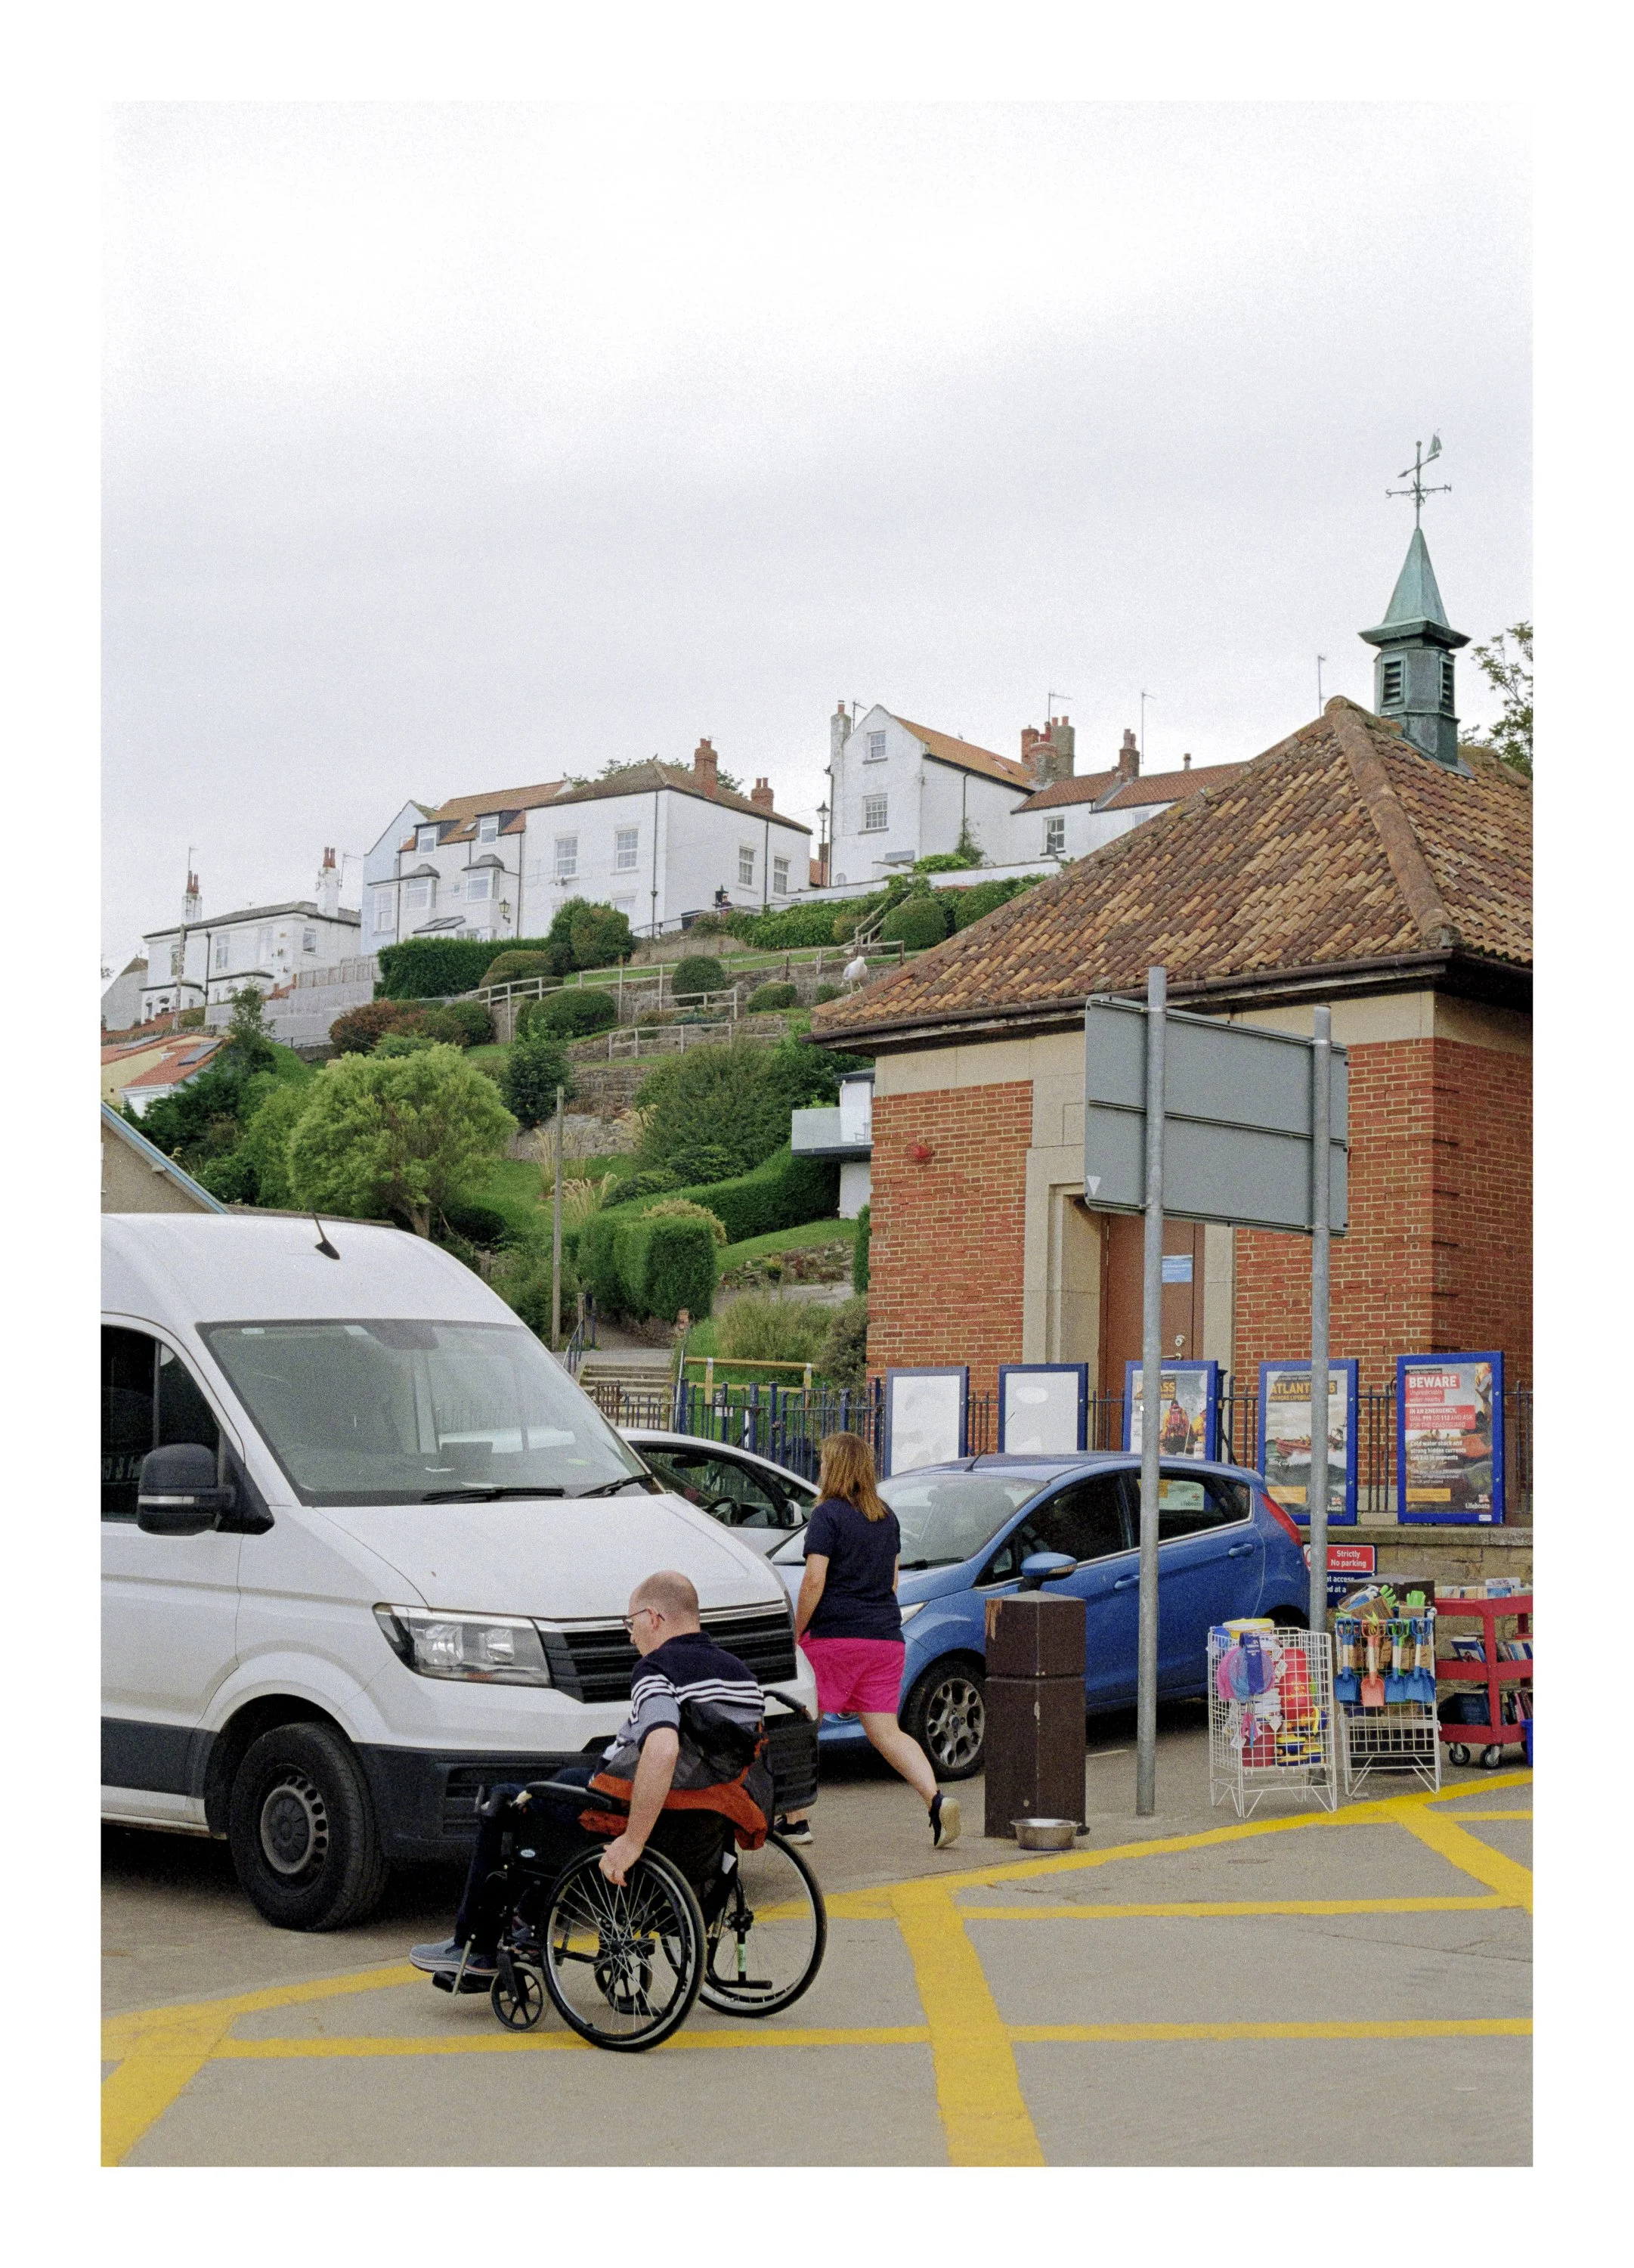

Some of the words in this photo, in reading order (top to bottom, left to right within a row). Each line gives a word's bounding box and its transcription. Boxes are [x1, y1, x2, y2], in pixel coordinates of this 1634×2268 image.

[1409, 1375, 1456, 1388] BEWARE
[1270, 1382, 1311, 1394] ATLANT
[1329, 1382, 1335, 1393] 5
[1337, 1550, 1360, 1558] Strictly
[1341, 1560, 1366, 1568] parking
